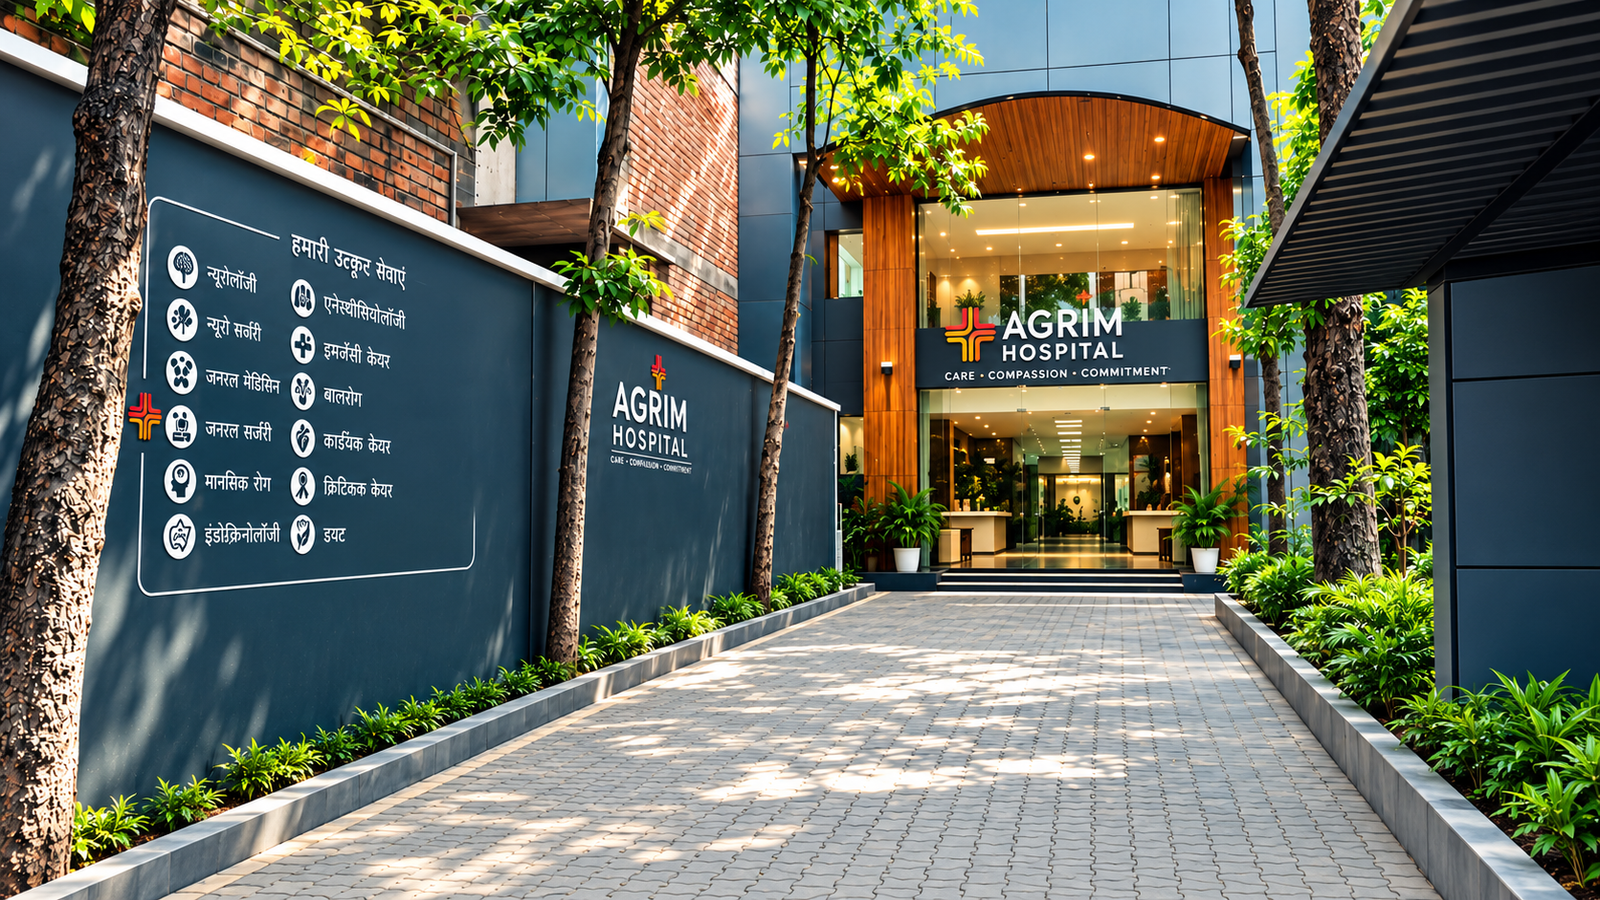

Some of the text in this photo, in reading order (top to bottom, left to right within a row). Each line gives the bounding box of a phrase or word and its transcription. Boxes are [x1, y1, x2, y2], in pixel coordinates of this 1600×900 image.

[290, 233, 330, 264] हमारी
[375, 253, 407, 291] सेवाएं
[206, 265, 258, 294] न्यूरोलॉजी
[323, 292, 407, 330] एनेस्थीसियोलॉजी
[1002, 307, 1123, 340] AGRIM
[206, 314, 231, 339] न्यूरो
[366, 345, 391, 370] केयर
[1001, 341, 1124, 363] HOSPITAL
[206, 369, 281, 395] जनरल मेडिसिन
[944, 366, 1168, 381] CARE COMPASSION COMMITMENT
[323, 385, 363, 408] बालरोग
[612, 381, 688, 433] AGRIM
[205, 420, 273, 442] जनरल सर्जरी
[367, 432, 392, 455] केयर
[612, 424, 688, 459] HOSPITAL
[204, 469, 272, 492] मानसिक रोग
[370, 477, 394, 499] केयर
